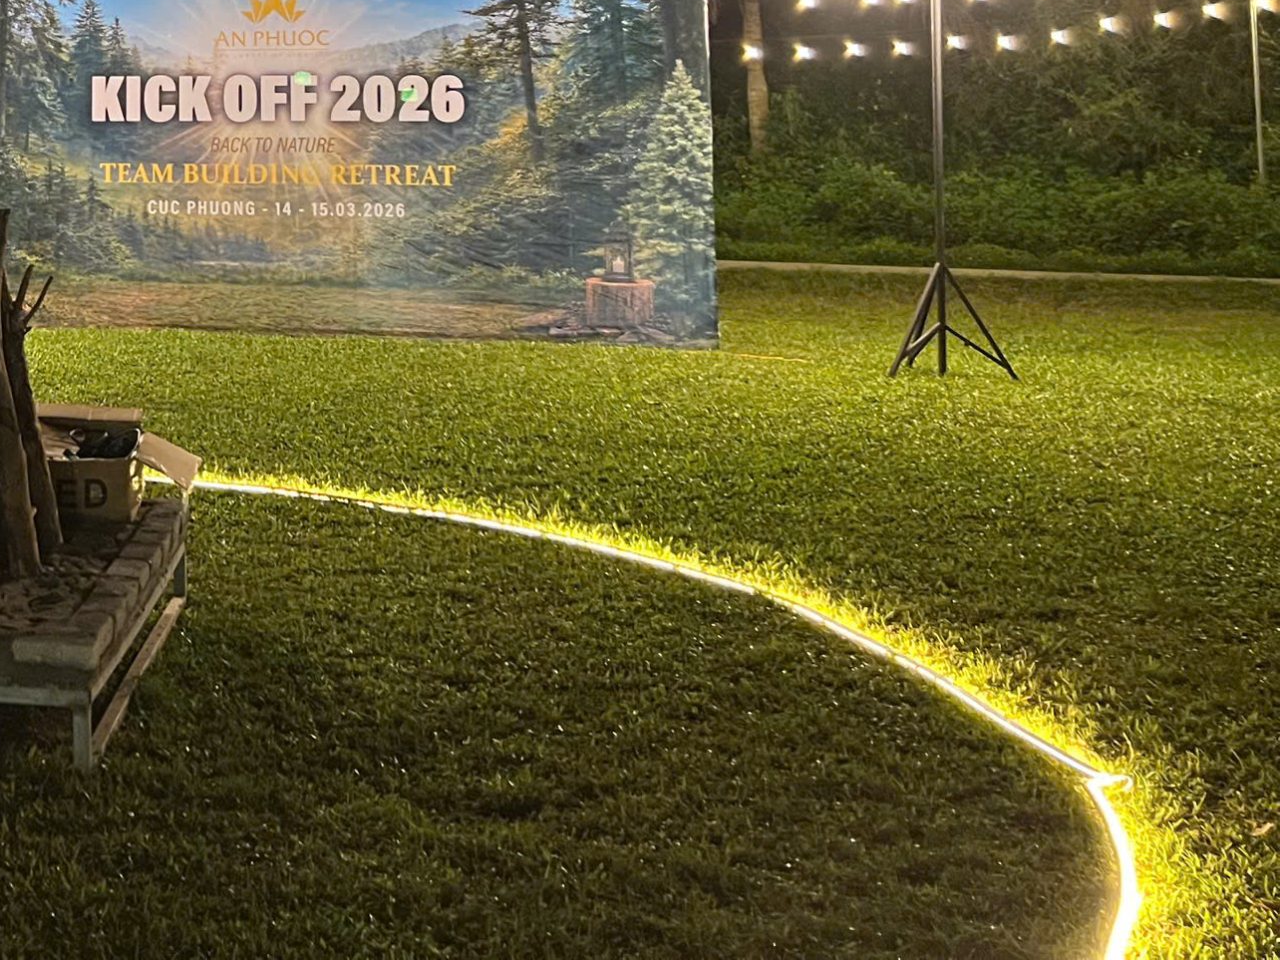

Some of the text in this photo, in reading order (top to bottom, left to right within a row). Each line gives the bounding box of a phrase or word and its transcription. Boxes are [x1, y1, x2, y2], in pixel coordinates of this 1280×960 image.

[215, 29, 330, 47] AN PHUOC
[91, 74, 465, 123] KICK OFF 2026
[210, 137, 336, 154] BACK TO NATURE
[99, 162, 457, 187] TEAM BUILDING RETREAT
[146, 199, 180, 215] CUC
[186, 200, 255, 216] PHUONG
[274, 201, 292, 217] 14
[312, 202, 406, 218] 15.03.2026
